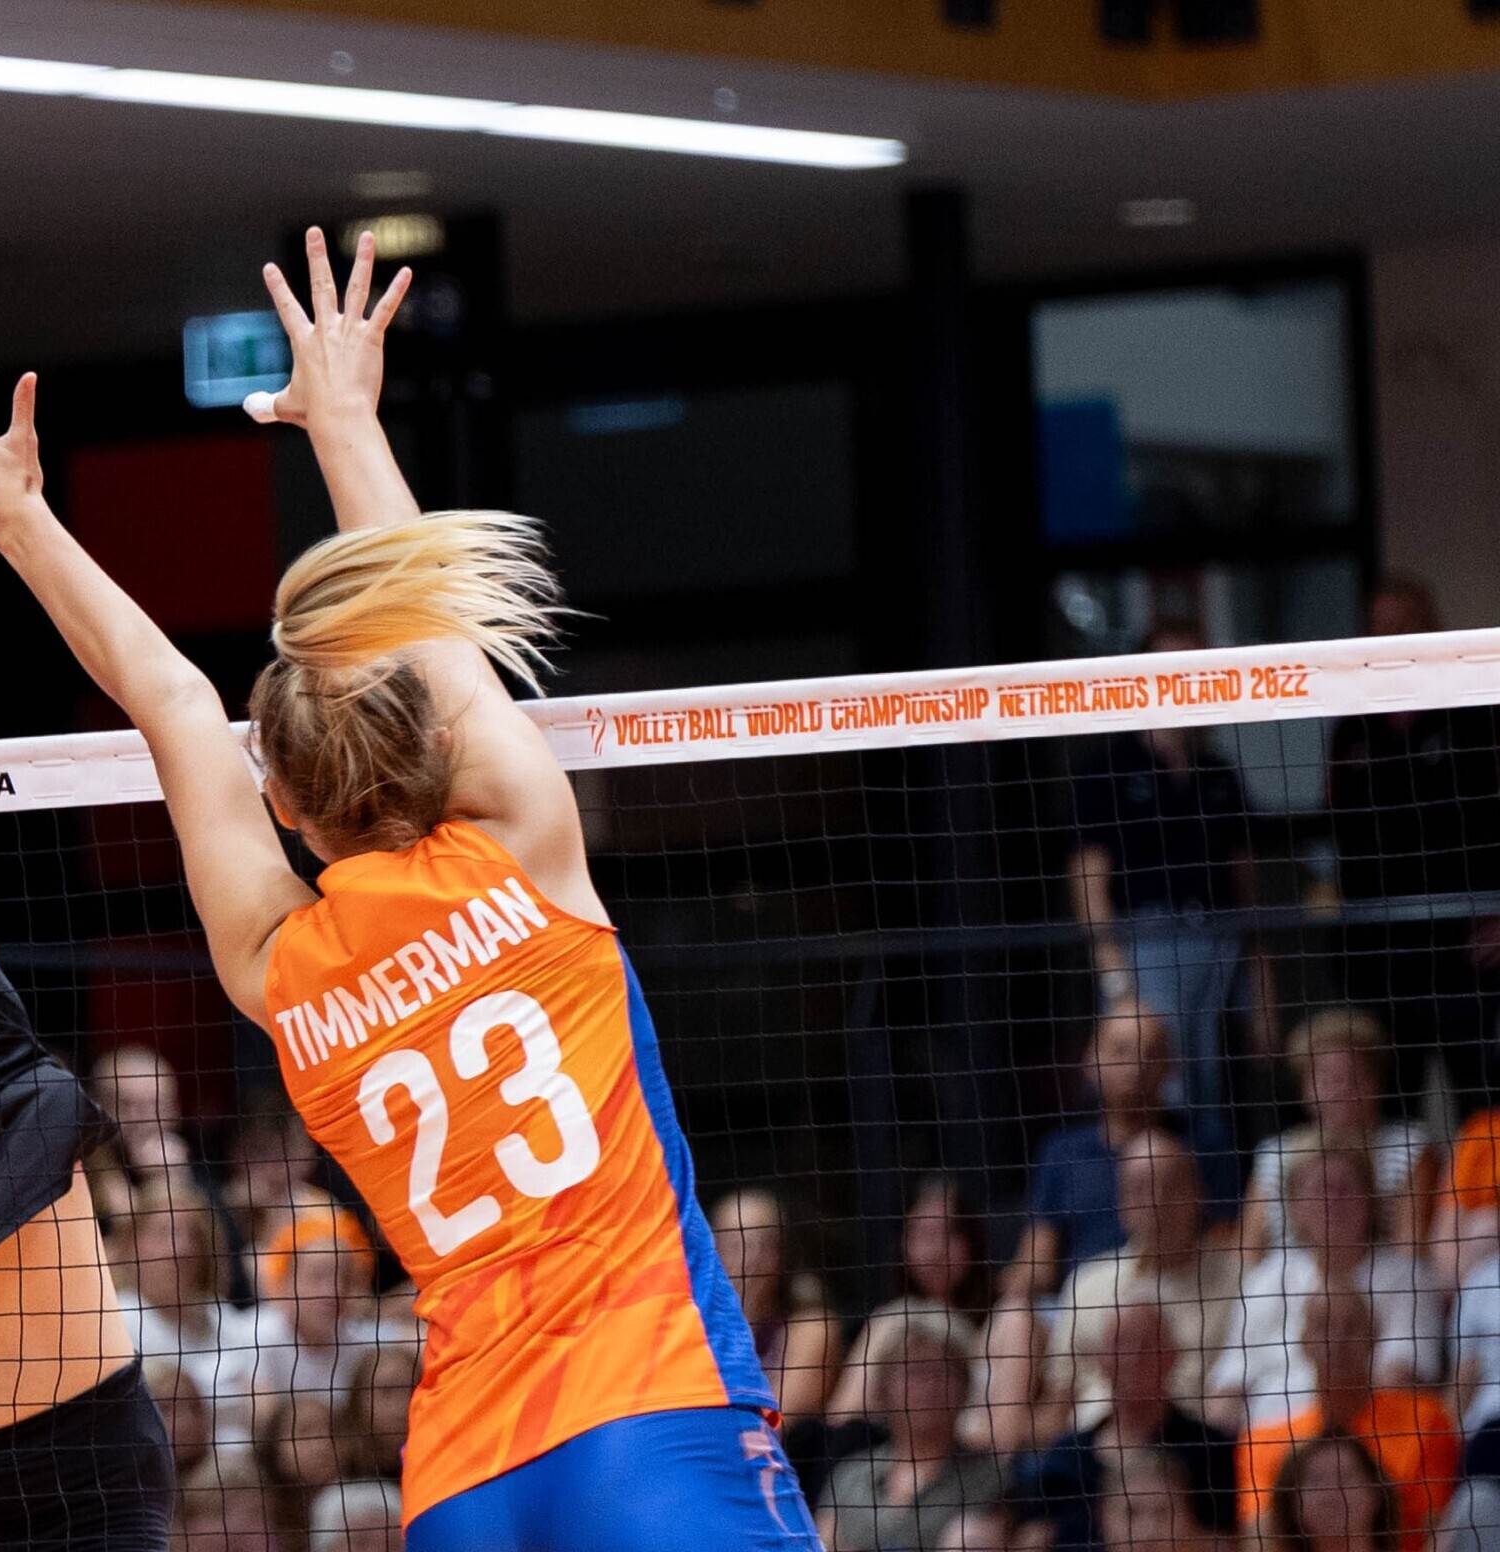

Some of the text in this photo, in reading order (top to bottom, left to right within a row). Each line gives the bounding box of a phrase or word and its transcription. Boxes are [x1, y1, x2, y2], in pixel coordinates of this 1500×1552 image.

[613, 663, 1309, 746] VOLLEYBALL WORLD CHAMPIONSHIP NETHERLANDS POLAND 2022
[275, 876, 549, 1072] TIMMERMAN
[356, 989, 601, 1258] 23
